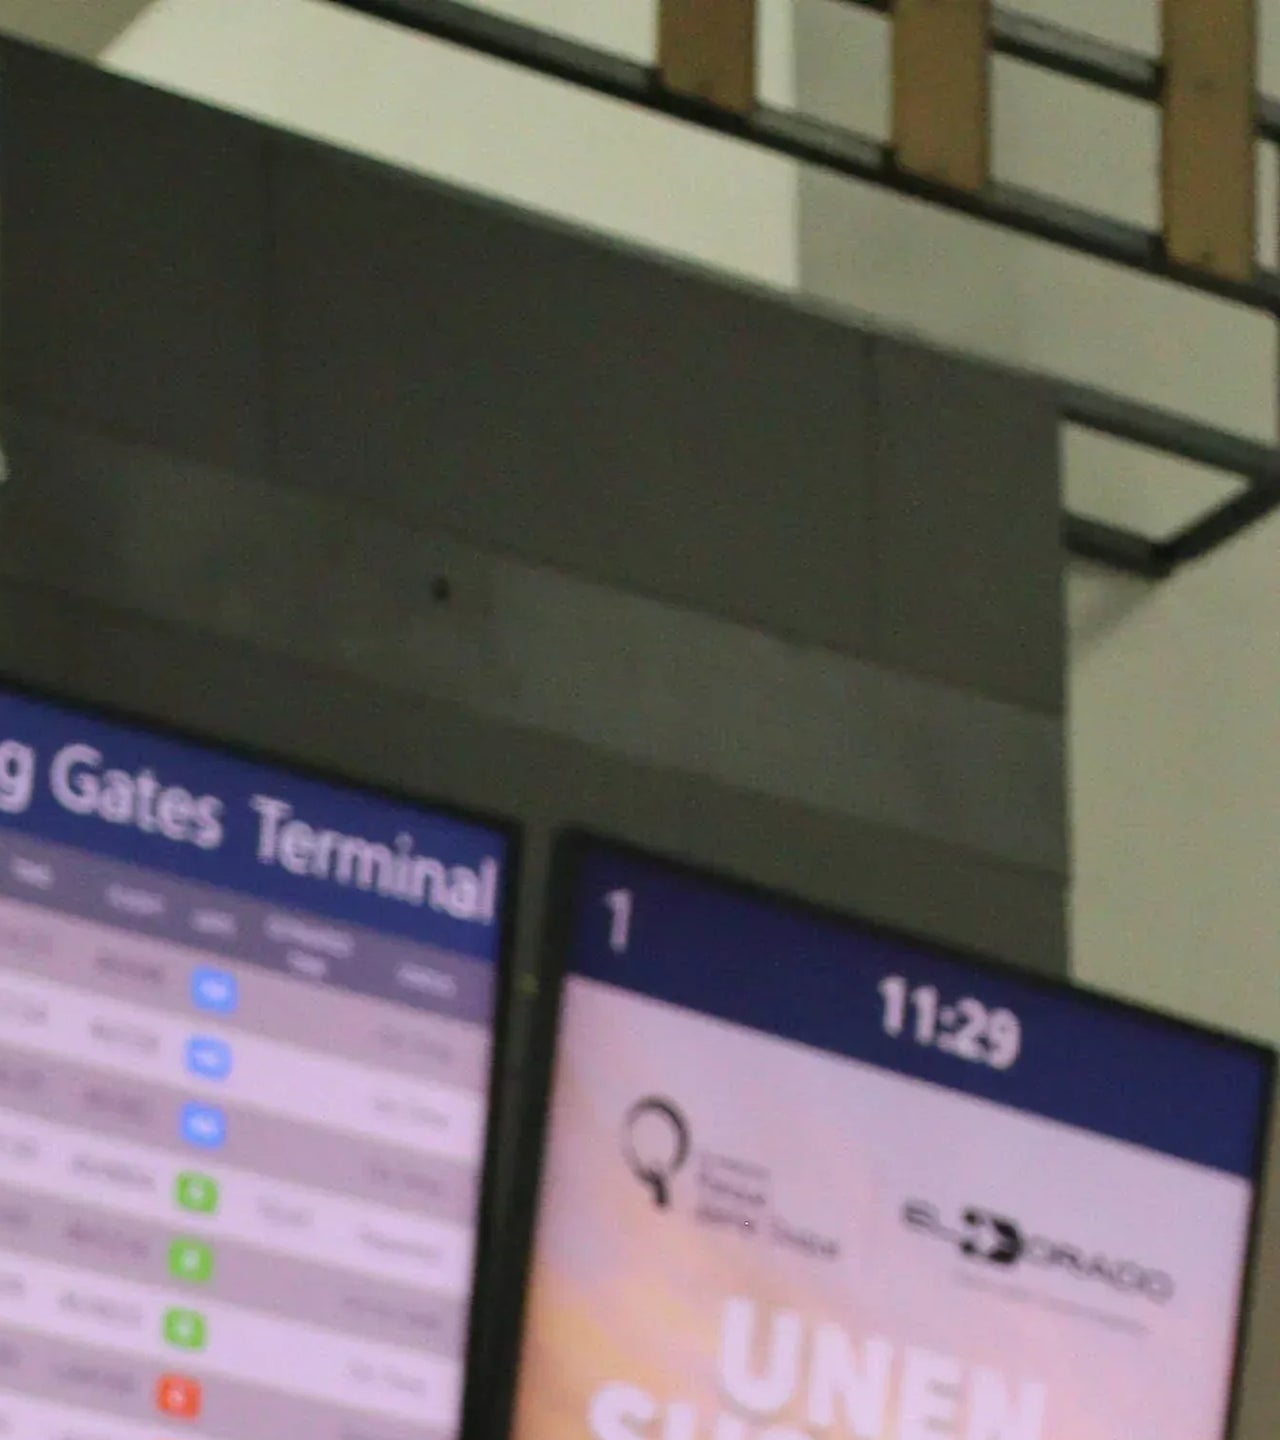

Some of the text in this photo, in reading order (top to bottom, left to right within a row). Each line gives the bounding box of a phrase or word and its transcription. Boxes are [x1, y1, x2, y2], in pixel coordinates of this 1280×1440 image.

[50, 744, 223, 851] Gates
[250, 796, 498, 926] Terminal
[603, 887, 632, 953] 1
[878, 974, 1024, 1071] 11:29
